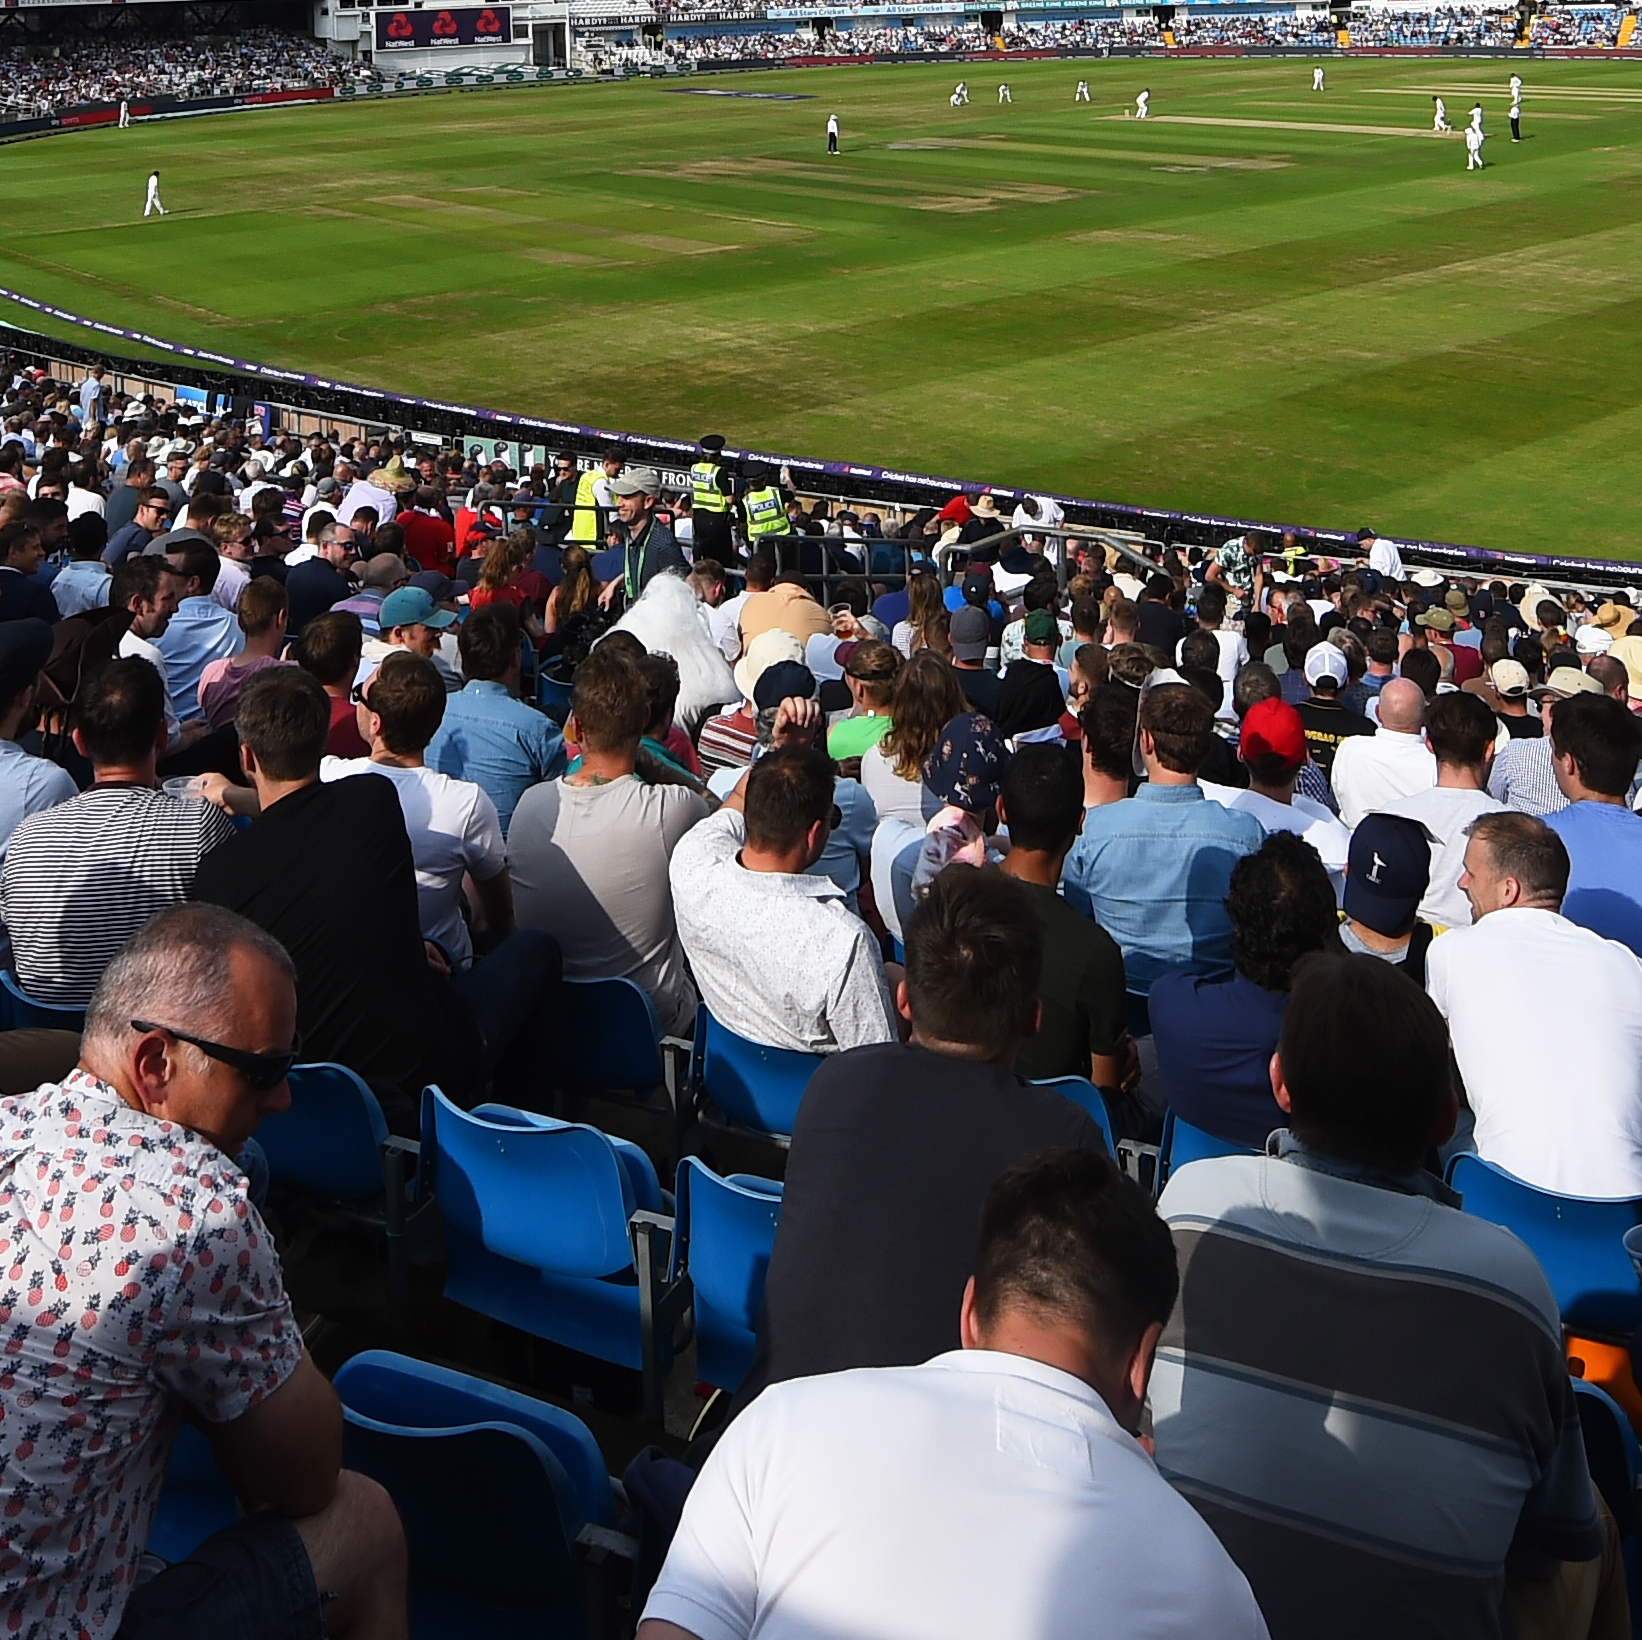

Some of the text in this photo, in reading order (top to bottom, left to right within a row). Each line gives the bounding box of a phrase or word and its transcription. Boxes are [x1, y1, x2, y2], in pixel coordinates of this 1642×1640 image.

[799, 9, 817, 17] Stars
[750, 499, 774, 515] POLICE
[1418, 543, 1466, 557] boundaries
[1587, 562, 1603, 571] has
